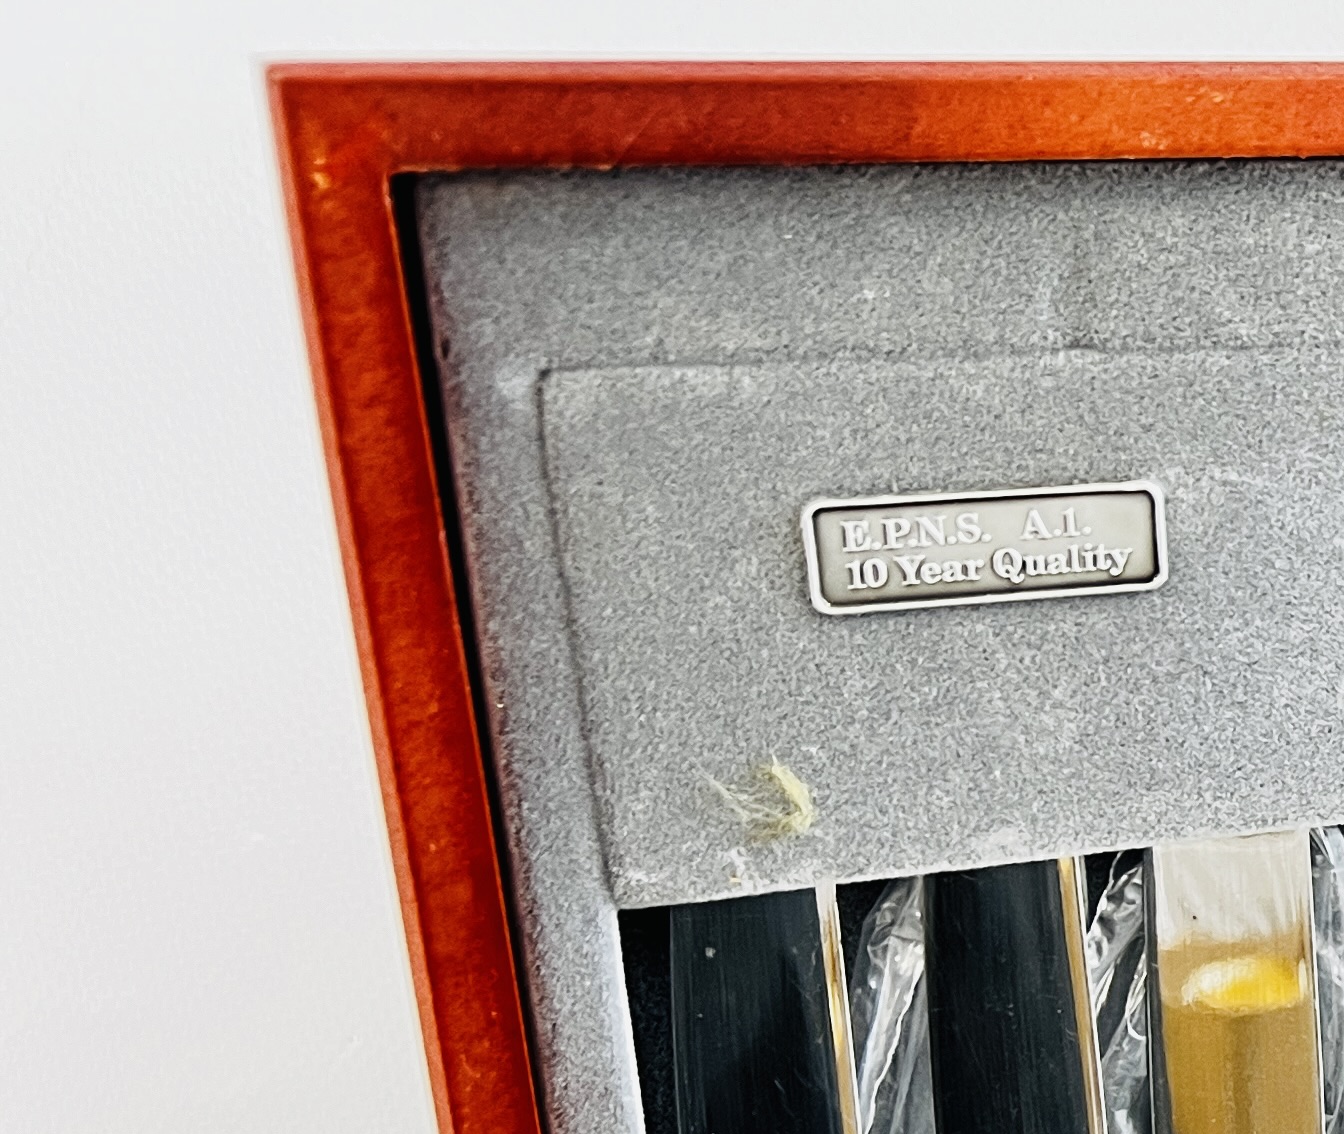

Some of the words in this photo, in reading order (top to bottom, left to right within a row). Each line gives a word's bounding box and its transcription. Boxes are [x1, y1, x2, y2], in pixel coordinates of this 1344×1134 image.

[840, 511, 992, 553] E.P.N.S.
[1020, 507, 1092, 541] A.1.
[847, 557, 888, 591] 10
[893, 553, 985, 587] Year
[992, 541, 1133, 584] Quality
